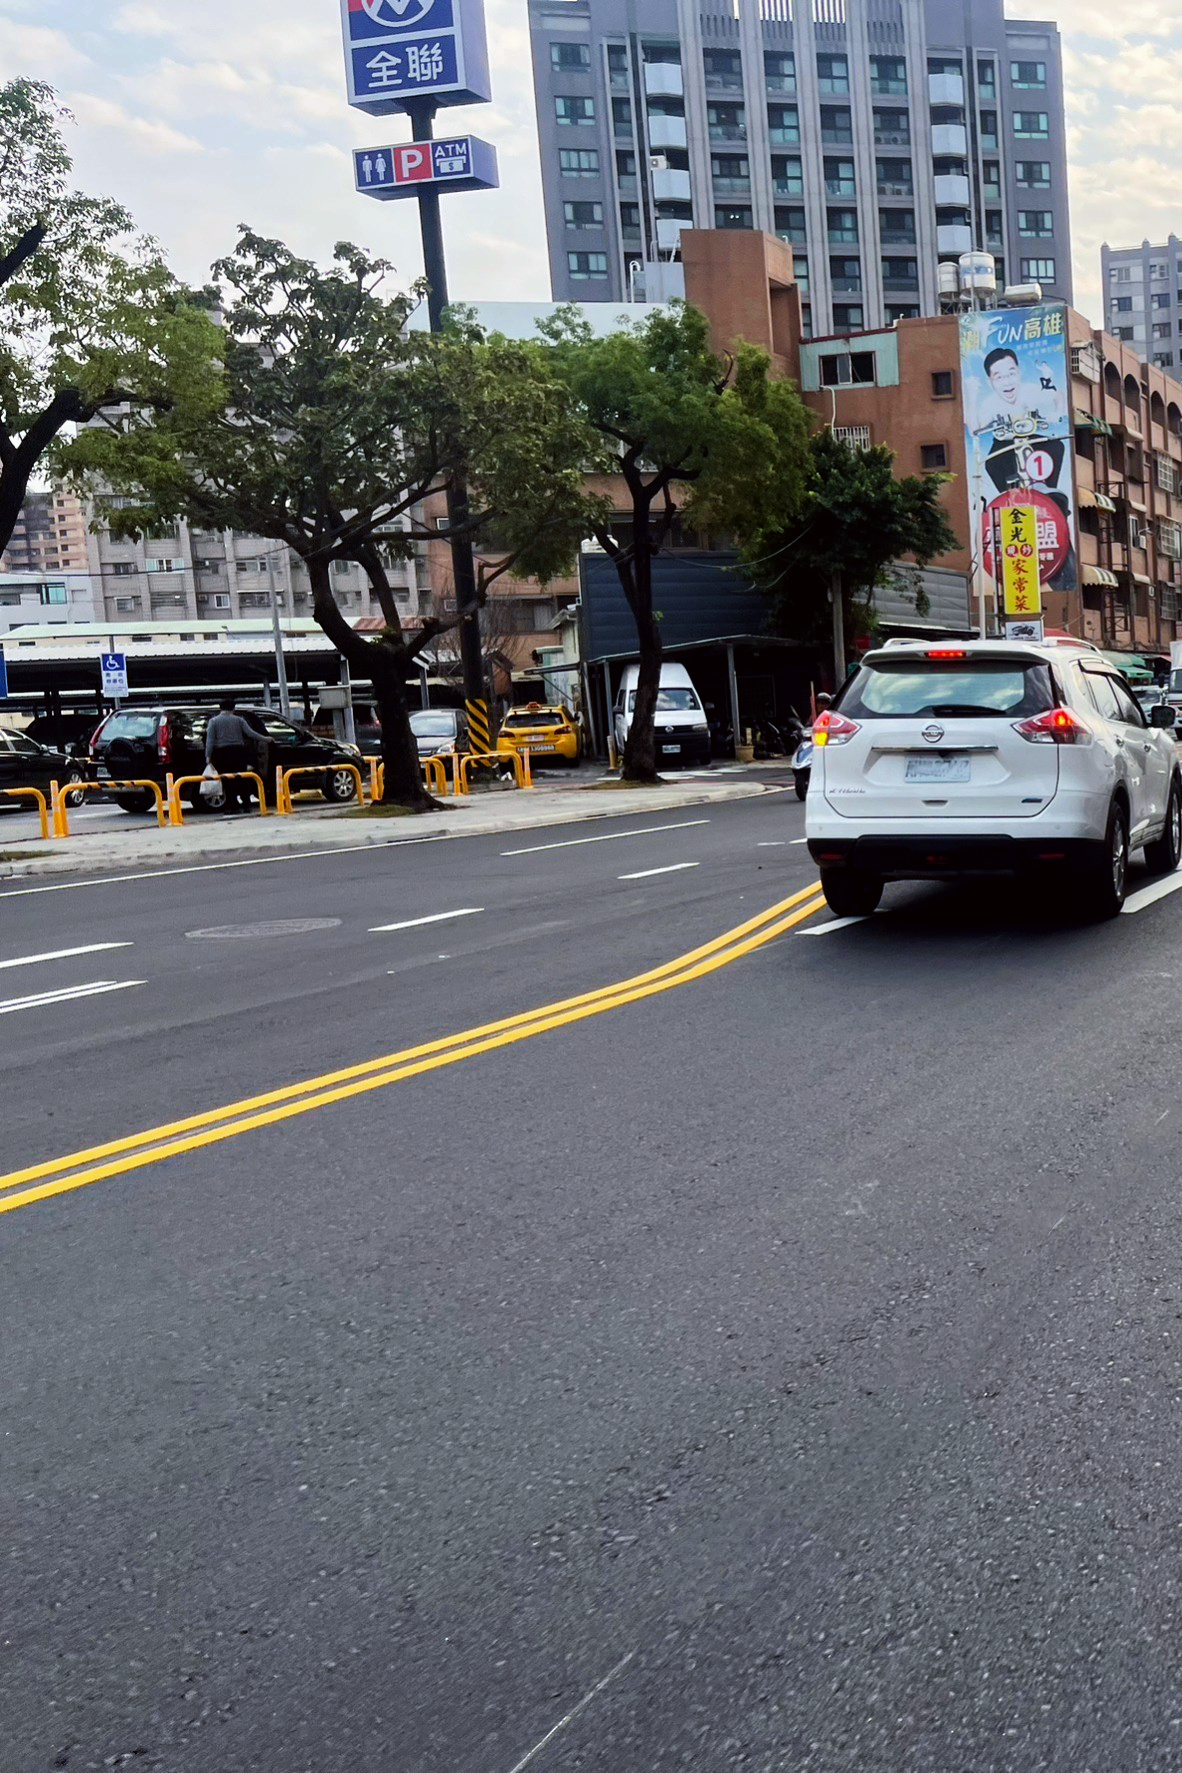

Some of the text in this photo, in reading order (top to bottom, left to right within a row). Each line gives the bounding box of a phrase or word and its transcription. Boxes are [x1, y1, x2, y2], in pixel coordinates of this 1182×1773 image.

[366, 42, 443, 89] 全聯
[401, 149, 423, 178] P
[434, 143, 467, 158] ATM
[1024, 312, 1063, 341] 高雄
[1034, 455, 1043, 477] 1
[1009, 507, 1028, 543] 金光
[1012, 559, 1031, 612] 家常菜
